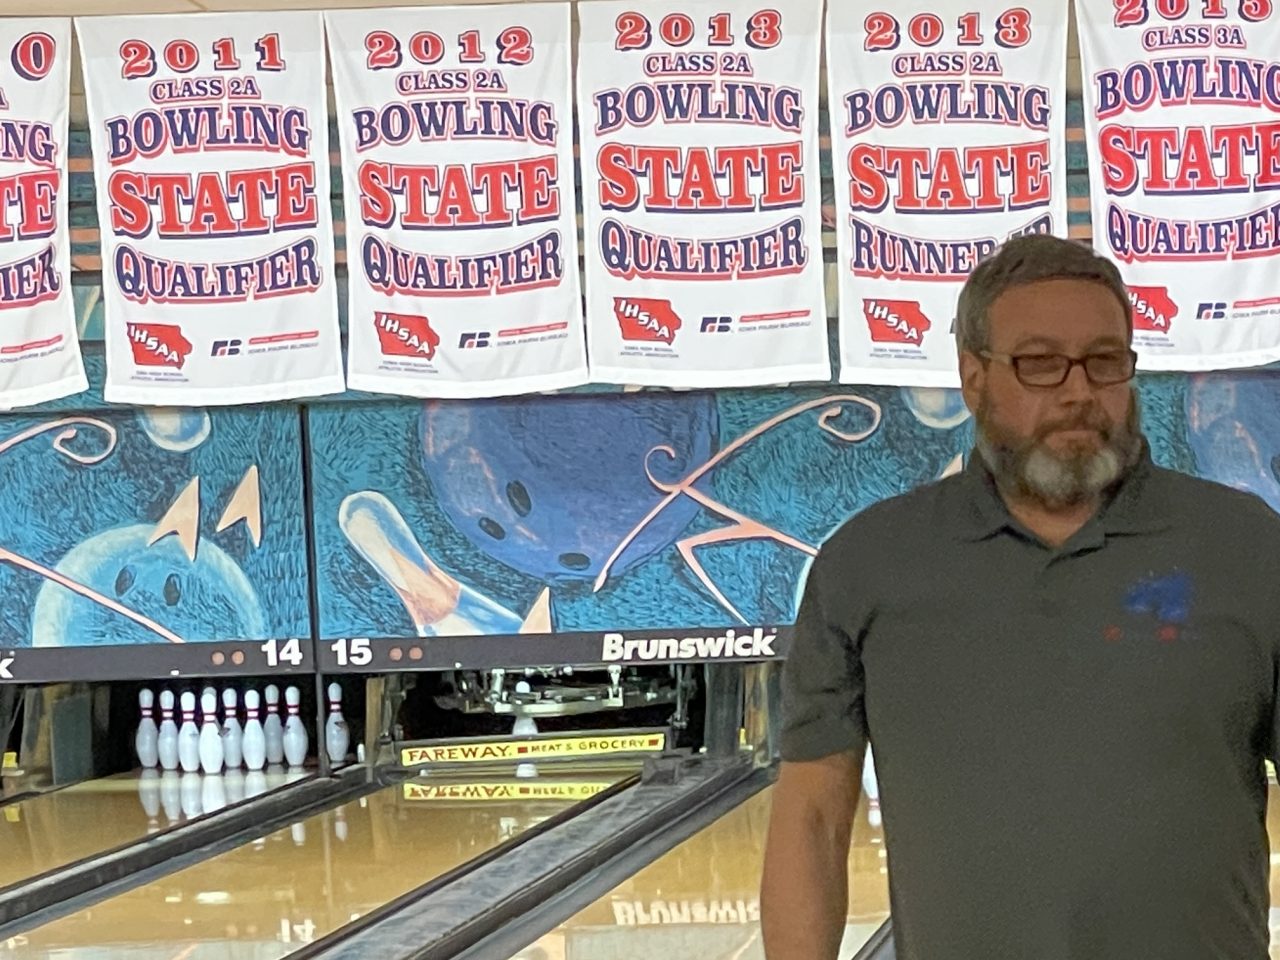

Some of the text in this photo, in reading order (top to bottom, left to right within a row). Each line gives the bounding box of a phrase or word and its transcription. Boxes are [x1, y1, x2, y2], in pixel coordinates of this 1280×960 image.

[365, 26, 535, 70] 2012
[615, 10, 783, 50] 2013
[864, 6, 1031, 50] 2013
[1144, 26, 1245, 48] CLASS 3A
[120, 33, 286, 79] 2011
[644, 53, 752, 75] CLASS 2A
[893, 53, 1001, 75] CLASS 2A
[151, 77, 260, 102] CLASS 2A
[397, 70, 506, 94] CLASS 2A
[353, 98, 558, 151] BOWLING
[595, 84, 804, 135] BOWLING
[845, 84, 1051, 135] BOWLING
[106, 105, 310, 162] BOWLING
[359, 154, 560, 230] STATE
[597, 141, 805, 213] STATE
[847, 140, 1051, 213] STATE
[108, 162, 318, 237] STATE
[362, 230, 563, 293] QUALIFIER
[600, 217, 807, 276] QUALIFIER
[114, 237, 321, 300] QUALIFIER
[619, 299, 670, 338] IHSAA
[868, 301, 919, 340] IHSAA
[1128, 293, 1166, 327] HSAA
[129, 325, 180, 364] IHSAA
[379, 314, 430, 354] IHSAA
[261, 640, 302, 666] 14
[331, 639, 373, 665] 15
[602, 628, 776, 660] Brunswick
[579, 739, 645, 750] GROCERY
